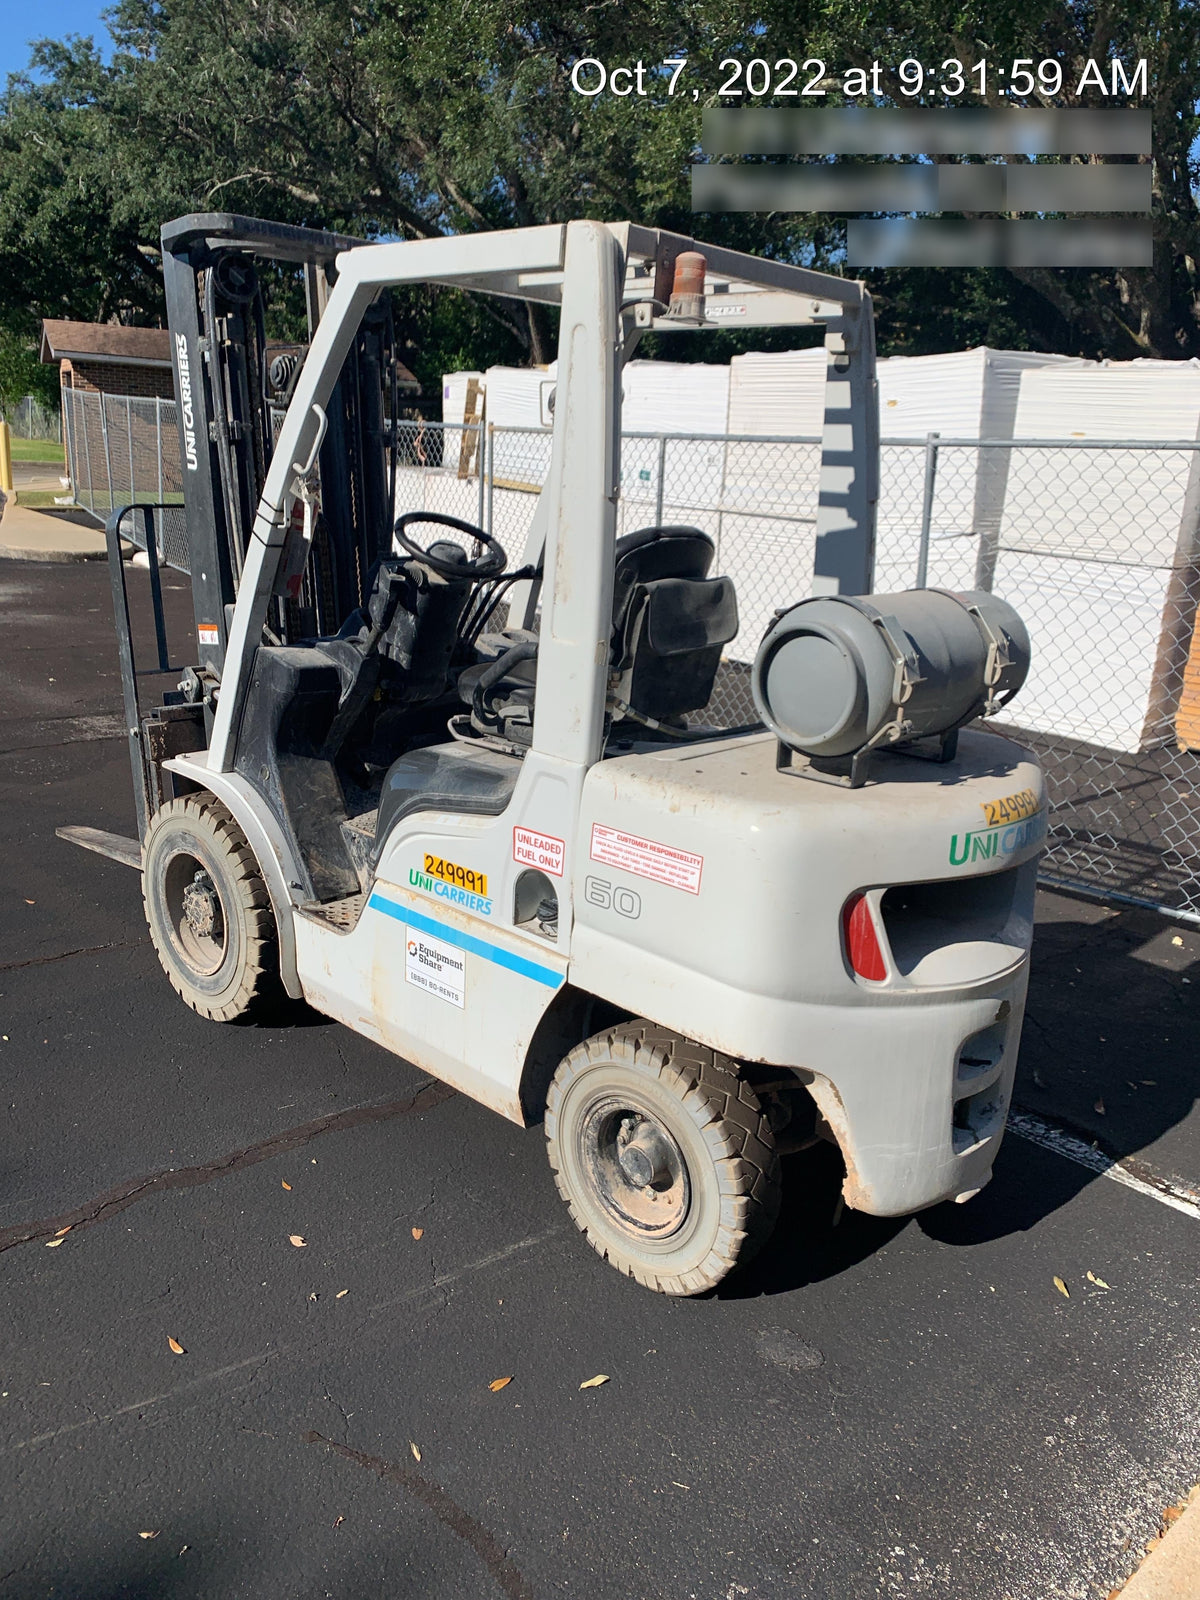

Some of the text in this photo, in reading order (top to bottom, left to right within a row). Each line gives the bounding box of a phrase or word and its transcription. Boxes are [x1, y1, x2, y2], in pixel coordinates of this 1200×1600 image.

[175, 331, 198, 471] UNICARRIERS
[984, 791, 1039, 826] 249991
[517, 832, 562, 855] UNLEADED
[517, 846, 561, 869] FUEL ONLY
[617, 834, 701, 866] CUSTOMER RESPONSIBILITY
[425, 854, 484, 895] 249991
[409, 868, 492, 916] UNICARRIERS
[584, 875, 642, 920] 60
[418, 942, 464, 972] Equipment
[418, 953, 443, 972] Share
[428, 981, 459, 1001] 80-RENTS
